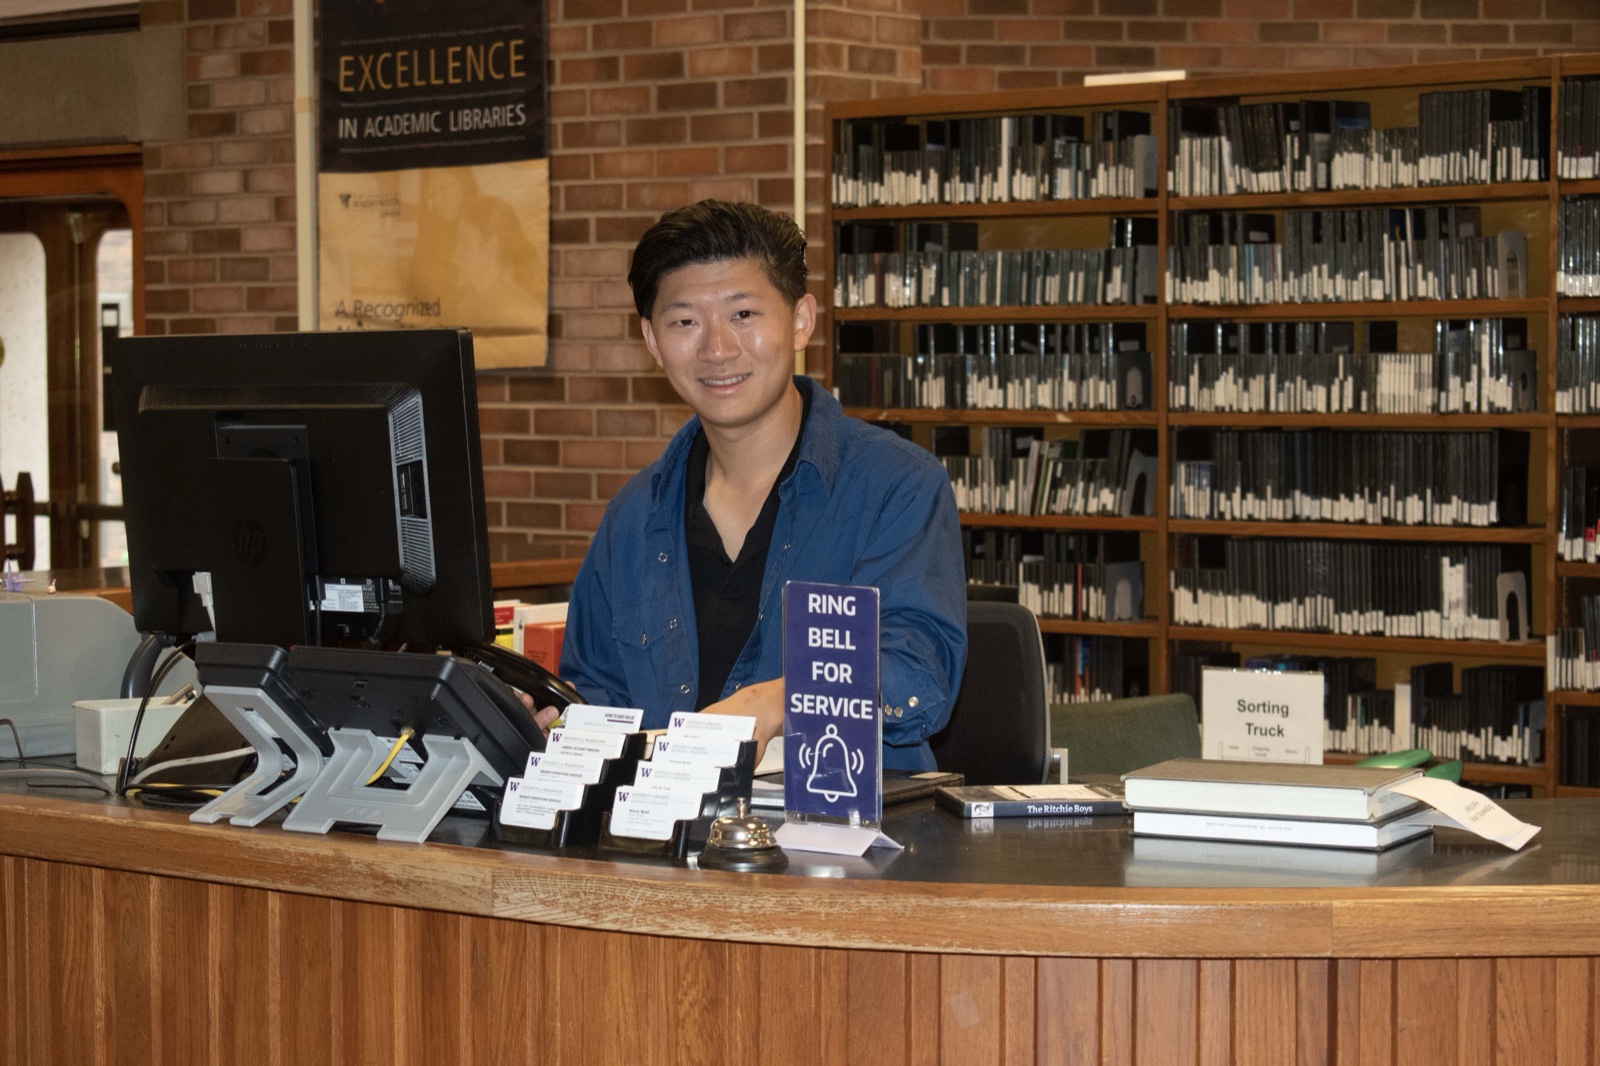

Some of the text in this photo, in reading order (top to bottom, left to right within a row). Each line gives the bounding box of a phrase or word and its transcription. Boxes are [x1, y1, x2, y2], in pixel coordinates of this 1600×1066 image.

[338, 39, 526, 93] EXCELLENCE
[338, 103, 527, 140] IN ACADEMIC LIBRARIES
[335, 296, 441, 323] A Recognized
[808, 593, 856, 617] RING
[808, 627, 856, 651] BELL
[811, 661, 853, 684] FOR
[790, 693, 873, 720] SERVICE
[1237, 699, 1289, 718] Sorting
[674, 718, 685, 728] W
[1245, 722, 1285, 738] Truck
[552, 732, 562, 743] W
[659, 741, 669, 752] W
[530, 756, 541, 767] W
[641, 767, 652, 778] W
[510, 781, 520, 792] W
[618, 791, 629, 802] W
[1027, 804, 1093, 815] The Ritchie Boys
